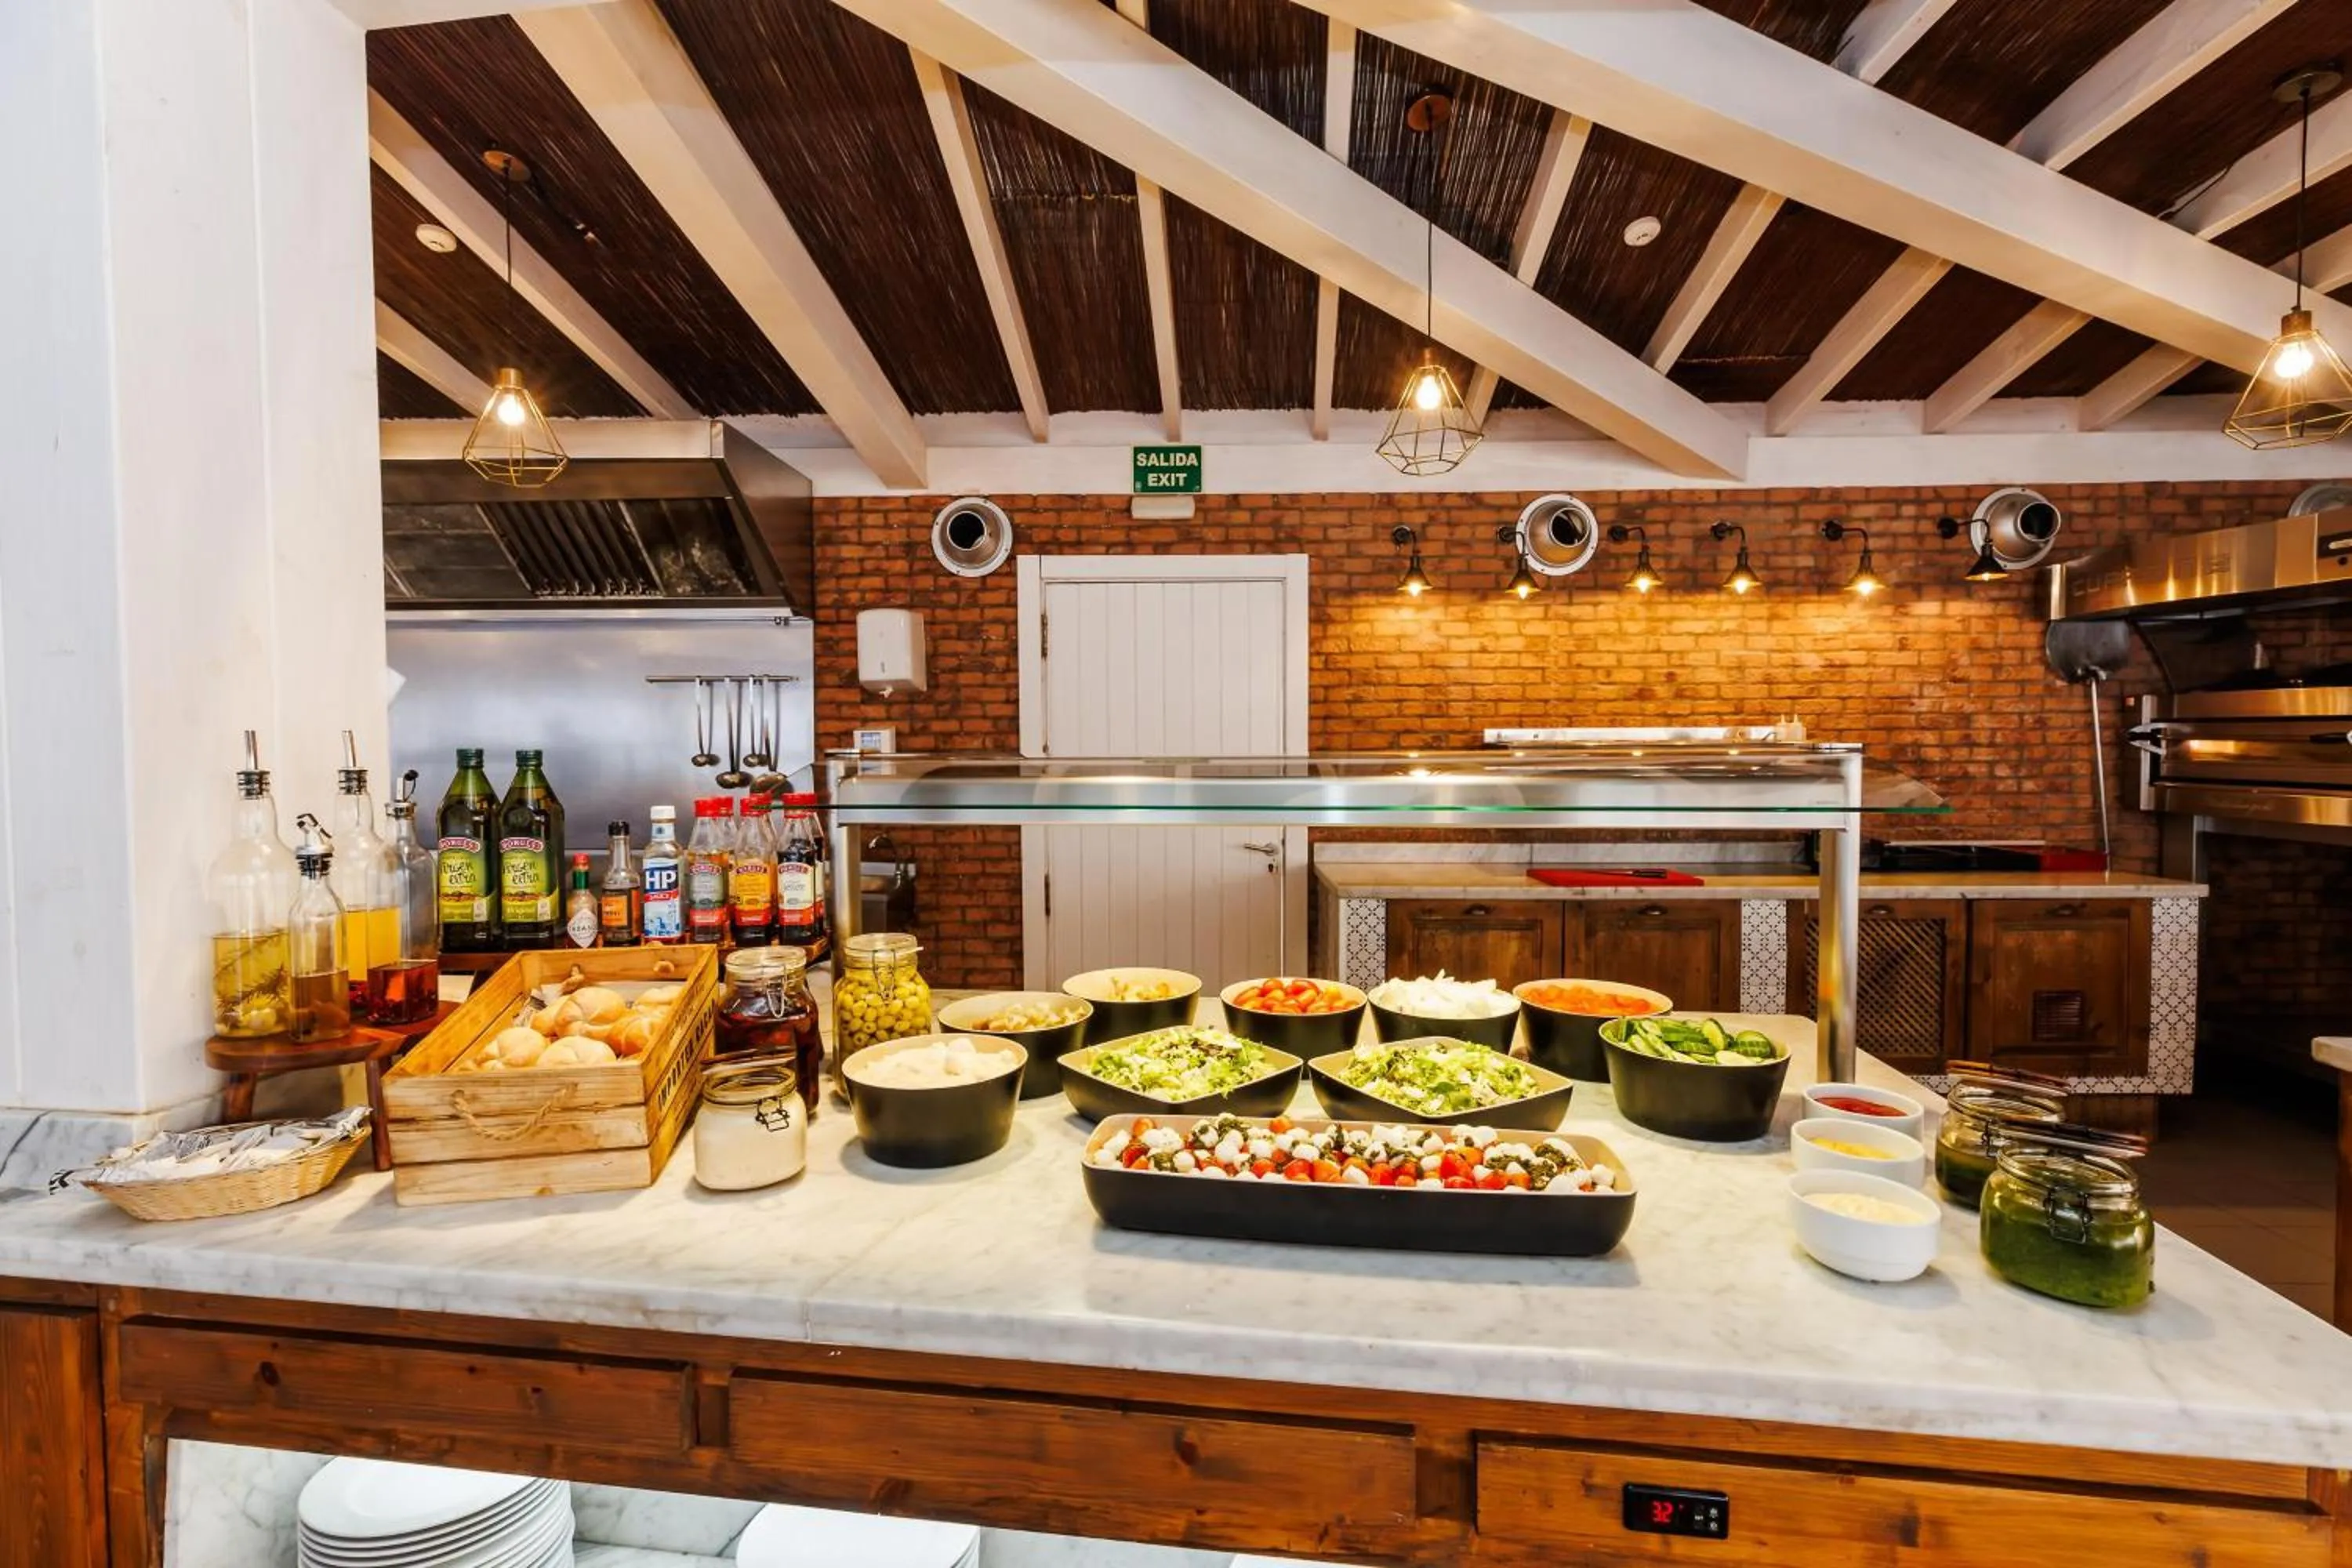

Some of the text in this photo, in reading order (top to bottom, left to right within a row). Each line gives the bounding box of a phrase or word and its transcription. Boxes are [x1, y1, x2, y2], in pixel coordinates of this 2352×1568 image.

[1136, 452, 1199, 466] SALIDA
[1147, 473, 1188, 487] EXIT
[645, 870, 677, 891] HP
